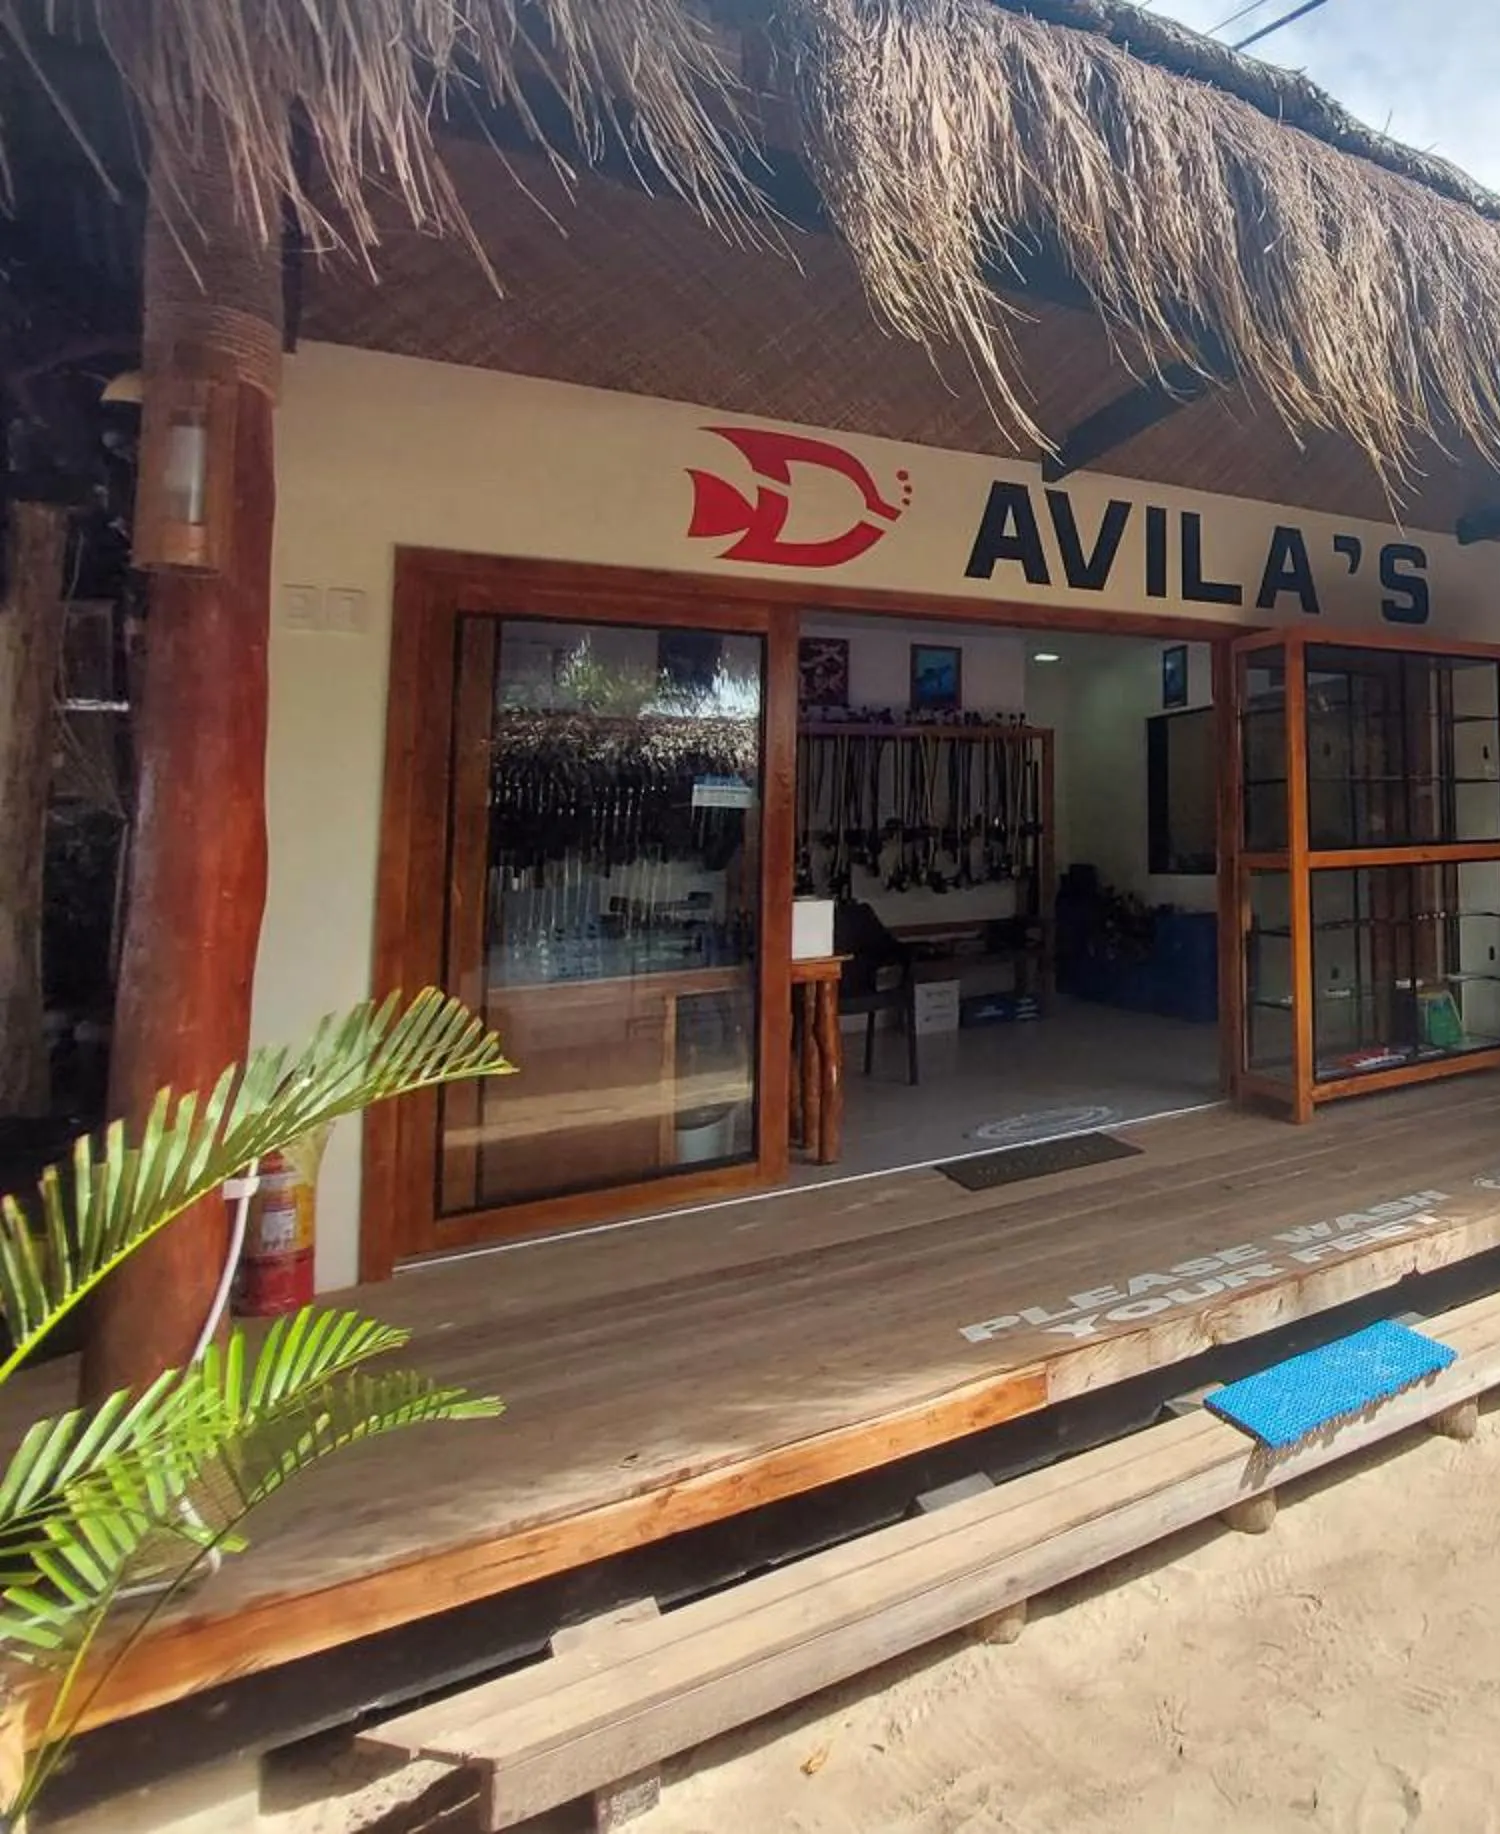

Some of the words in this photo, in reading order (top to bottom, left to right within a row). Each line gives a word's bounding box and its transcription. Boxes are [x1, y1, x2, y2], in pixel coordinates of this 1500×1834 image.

[964, 480, 1430, 624] AVILA'S
[959, 1243, 1268, 1343] PLEASE
[1272, 1190, 1451, 1243] WASH
[1041, 1263, 1287, 1337] YOUR
[1290, 1209, 1440, 1263] FEET
